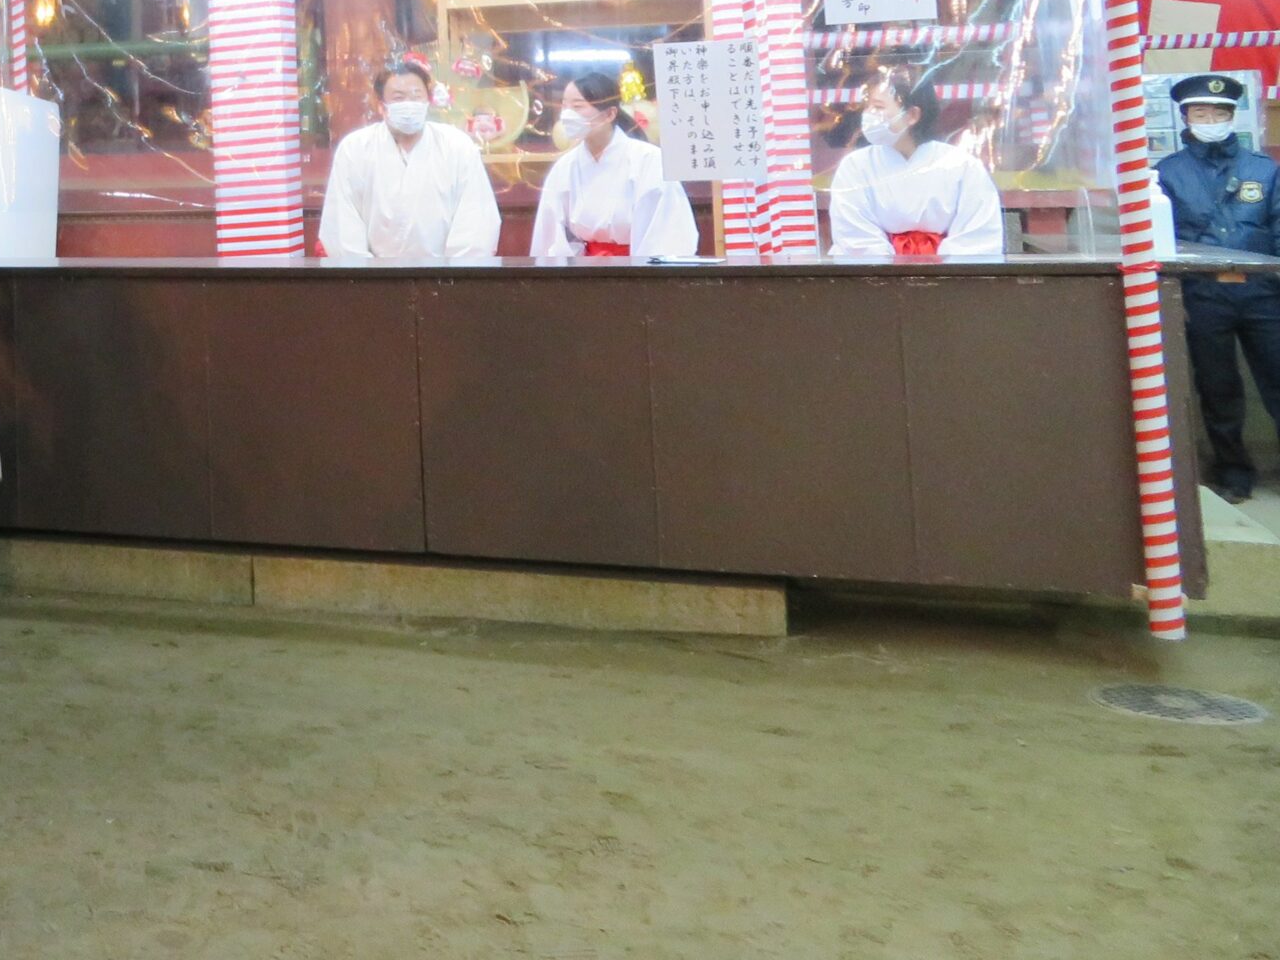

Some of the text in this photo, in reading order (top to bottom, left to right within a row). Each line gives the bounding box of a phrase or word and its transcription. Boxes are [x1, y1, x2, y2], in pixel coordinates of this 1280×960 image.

[740, 42, 762, 167] 順番だけ先に予約す
